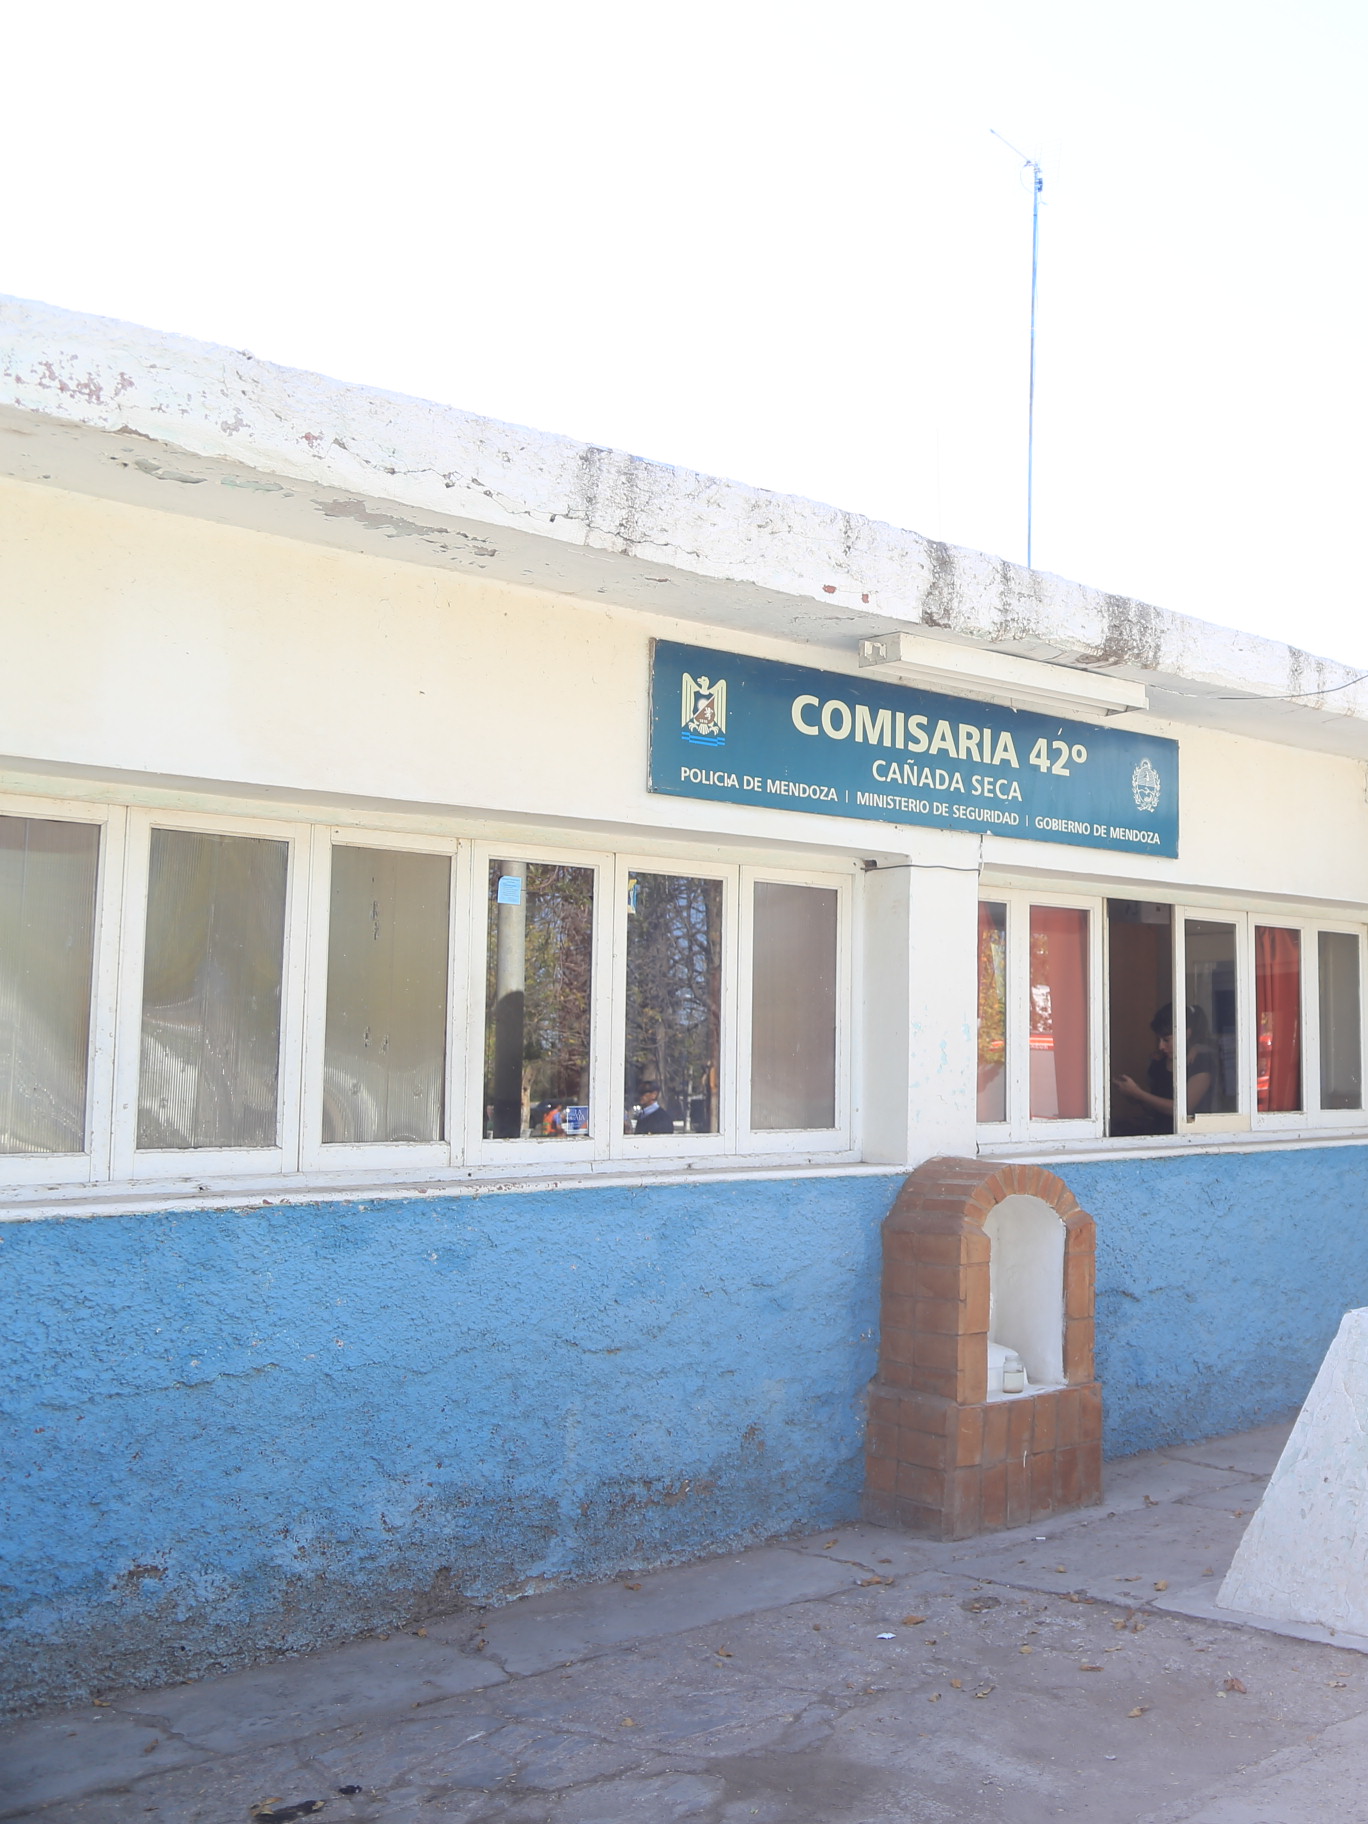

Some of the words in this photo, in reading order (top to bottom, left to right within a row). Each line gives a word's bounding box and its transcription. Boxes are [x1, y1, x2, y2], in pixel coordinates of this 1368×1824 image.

[791, 694, 1020, 769] COMISARIA
[680, 766, 740, 789] POLICIA
[743, 775, 763, 792] DE
[766, 778, 839, 802] MENDOZA
[856, 791, 930, 814] MINISTERIO
[932, 801, 950, 817] DE
[952, 804, 1020, 826] SEGURIDAD
[1034, 815, 1091, 836] GOBIERNO
[1093, 823, 1108, 838] DE
[1109, 826, 1161, 845] MENDOZA
[871, 759, 966, 794] CAÑADA
[971, 774, 1023, 802] SECA
